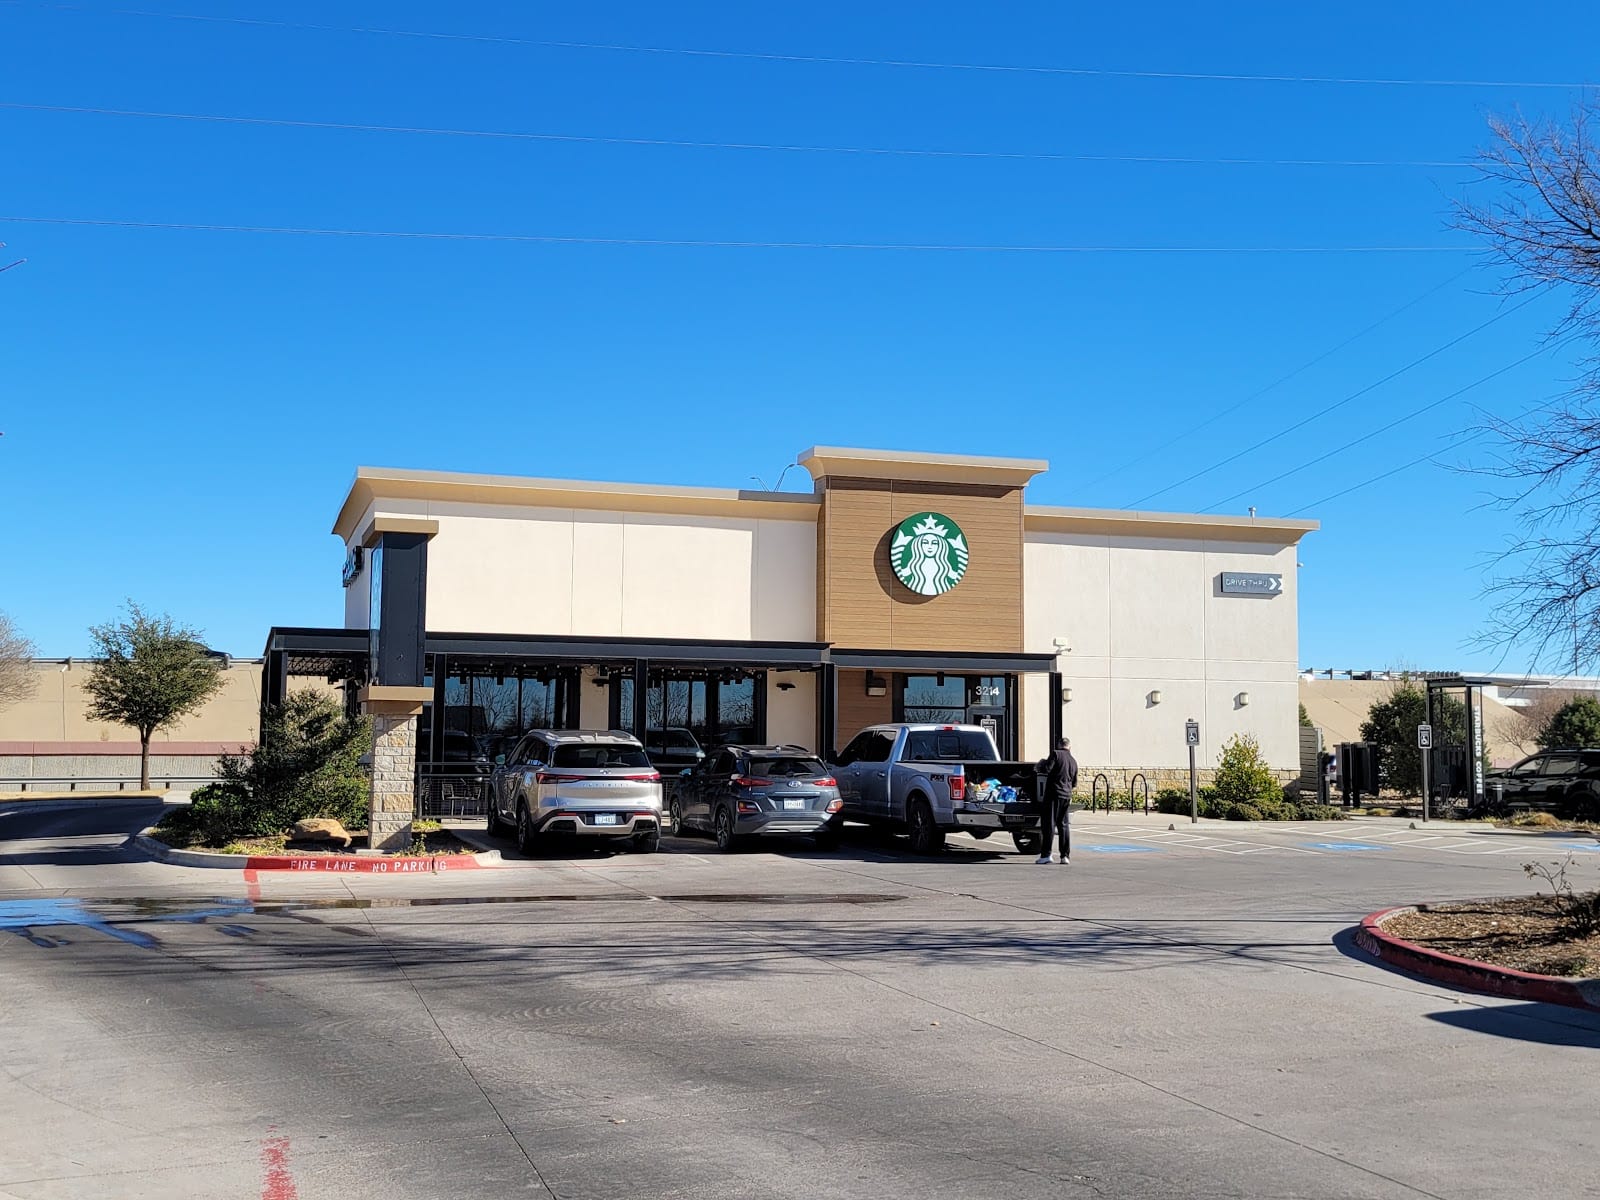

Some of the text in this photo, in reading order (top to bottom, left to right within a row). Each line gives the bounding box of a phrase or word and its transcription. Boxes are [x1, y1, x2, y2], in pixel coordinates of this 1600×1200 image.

[1225, 578, 1246, 586] DRIVE
[975, 685, 1000, 696] 3214
[1474, 705, 1482, 757] STARBUCKS
[290, 860, 447, 873] FIRE LANE NO PARKING
